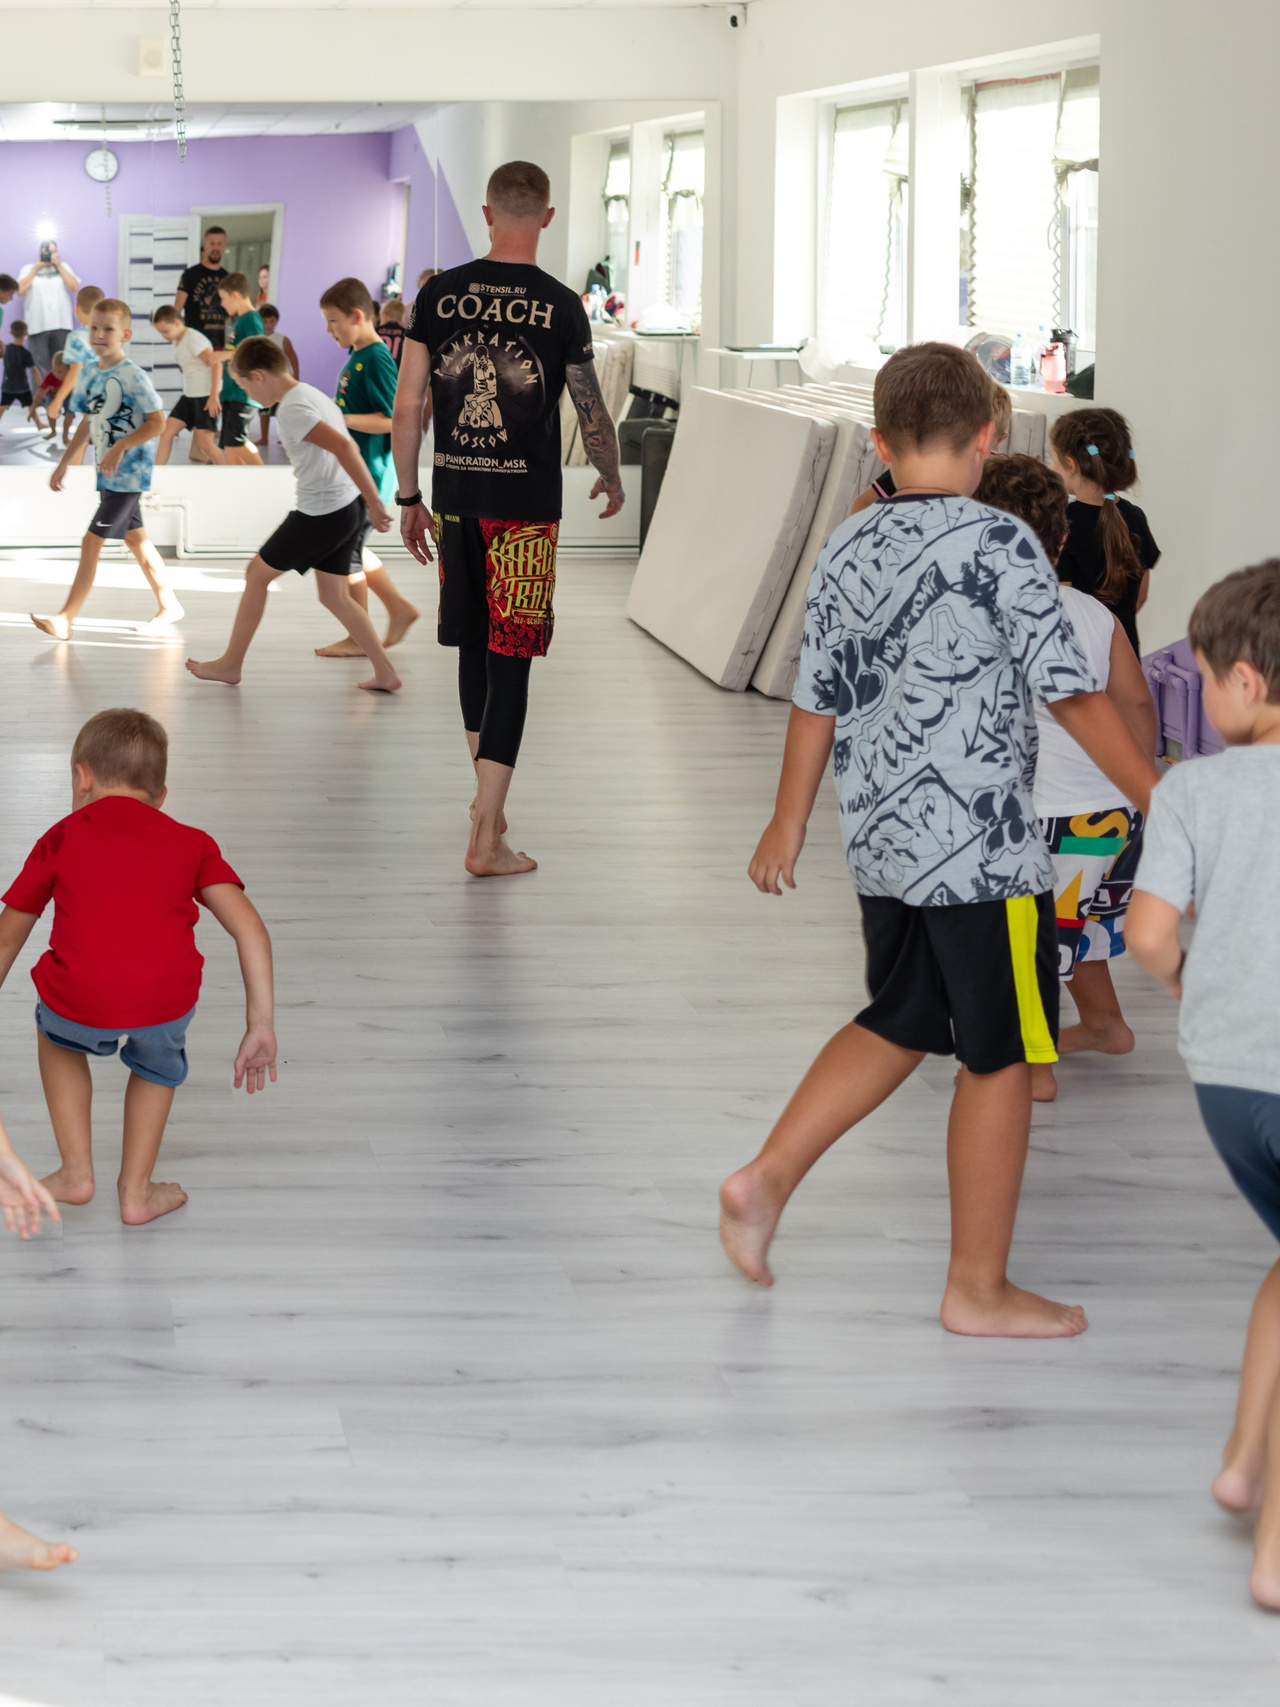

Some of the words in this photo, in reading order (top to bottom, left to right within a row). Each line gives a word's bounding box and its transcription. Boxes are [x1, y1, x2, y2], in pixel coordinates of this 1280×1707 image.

[481, 283, 527, 295] STENSIL.RU
[436, 294, 555, 329] COACH
[433, 330, 540, 386] PANKRATION
[451, 427, 509, 449] MOSCOW
